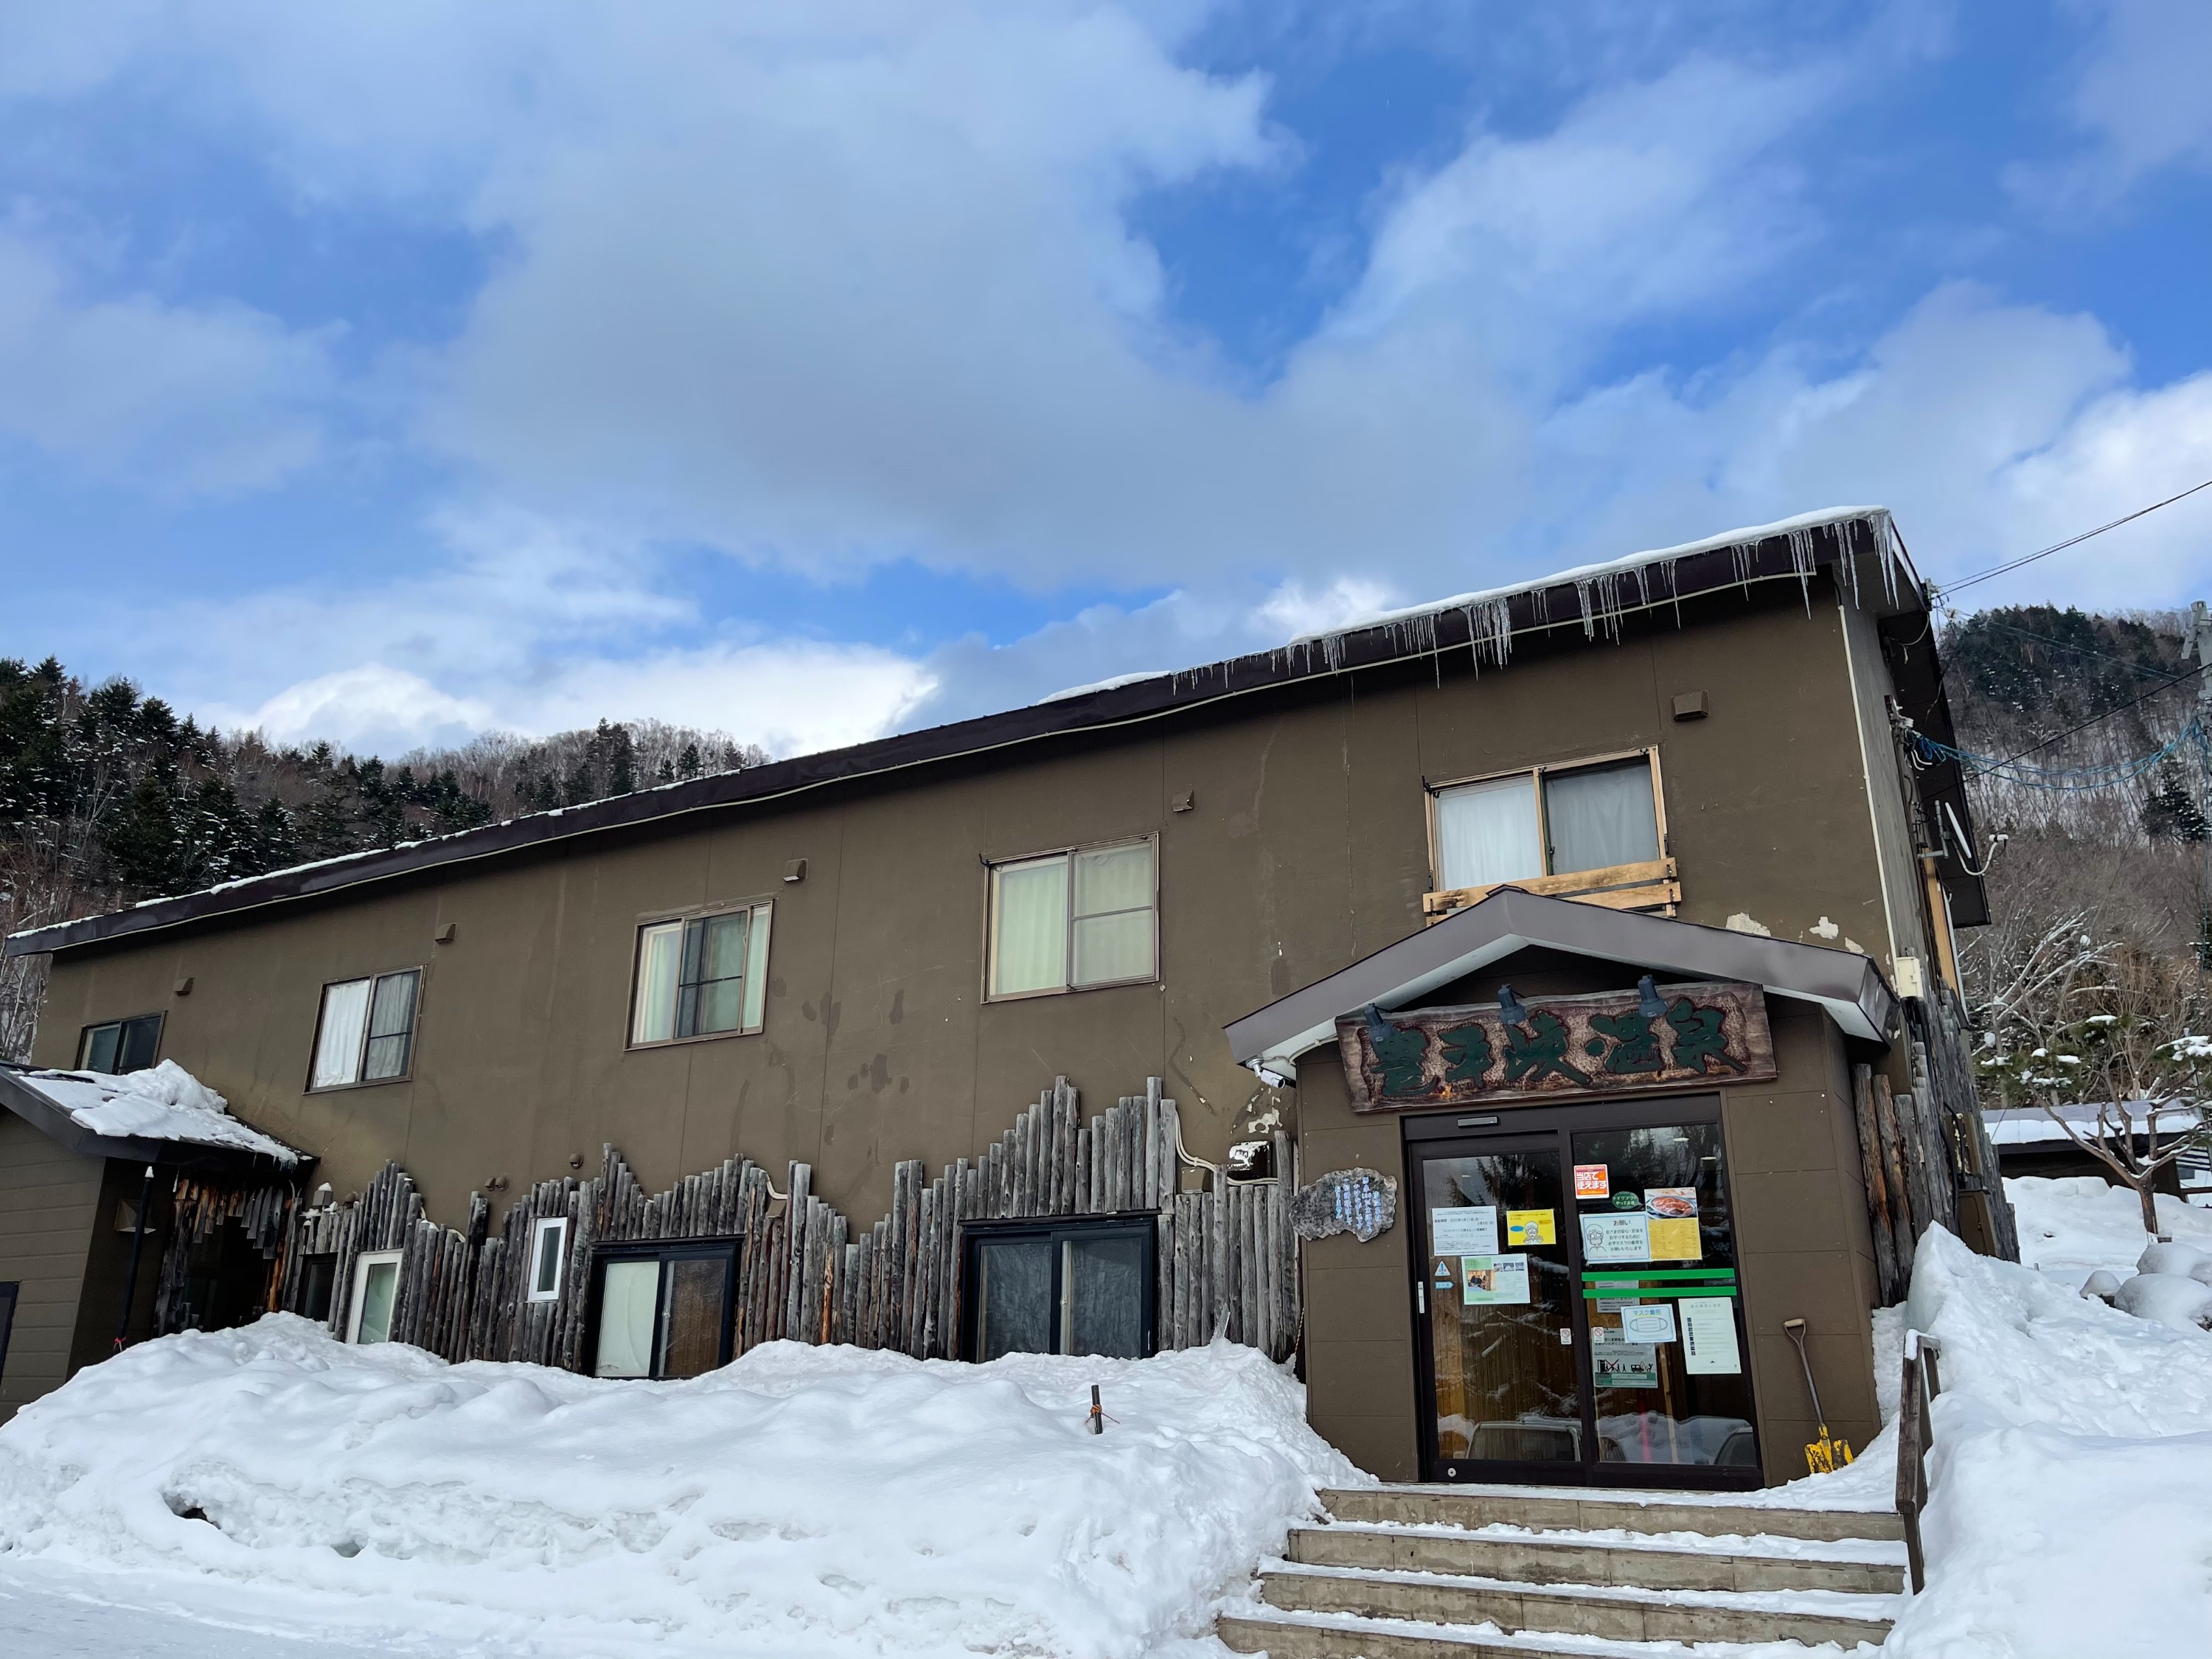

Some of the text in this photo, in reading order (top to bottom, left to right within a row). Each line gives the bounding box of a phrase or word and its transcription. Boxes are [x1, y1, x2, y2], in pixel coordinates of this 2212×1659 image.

[1371, 997, 1746, 1097] 豊平峡温泉
[1576, 1171, 1599, 1180] 当店で
[1577, 1181, 1607, 1189] 使えます
